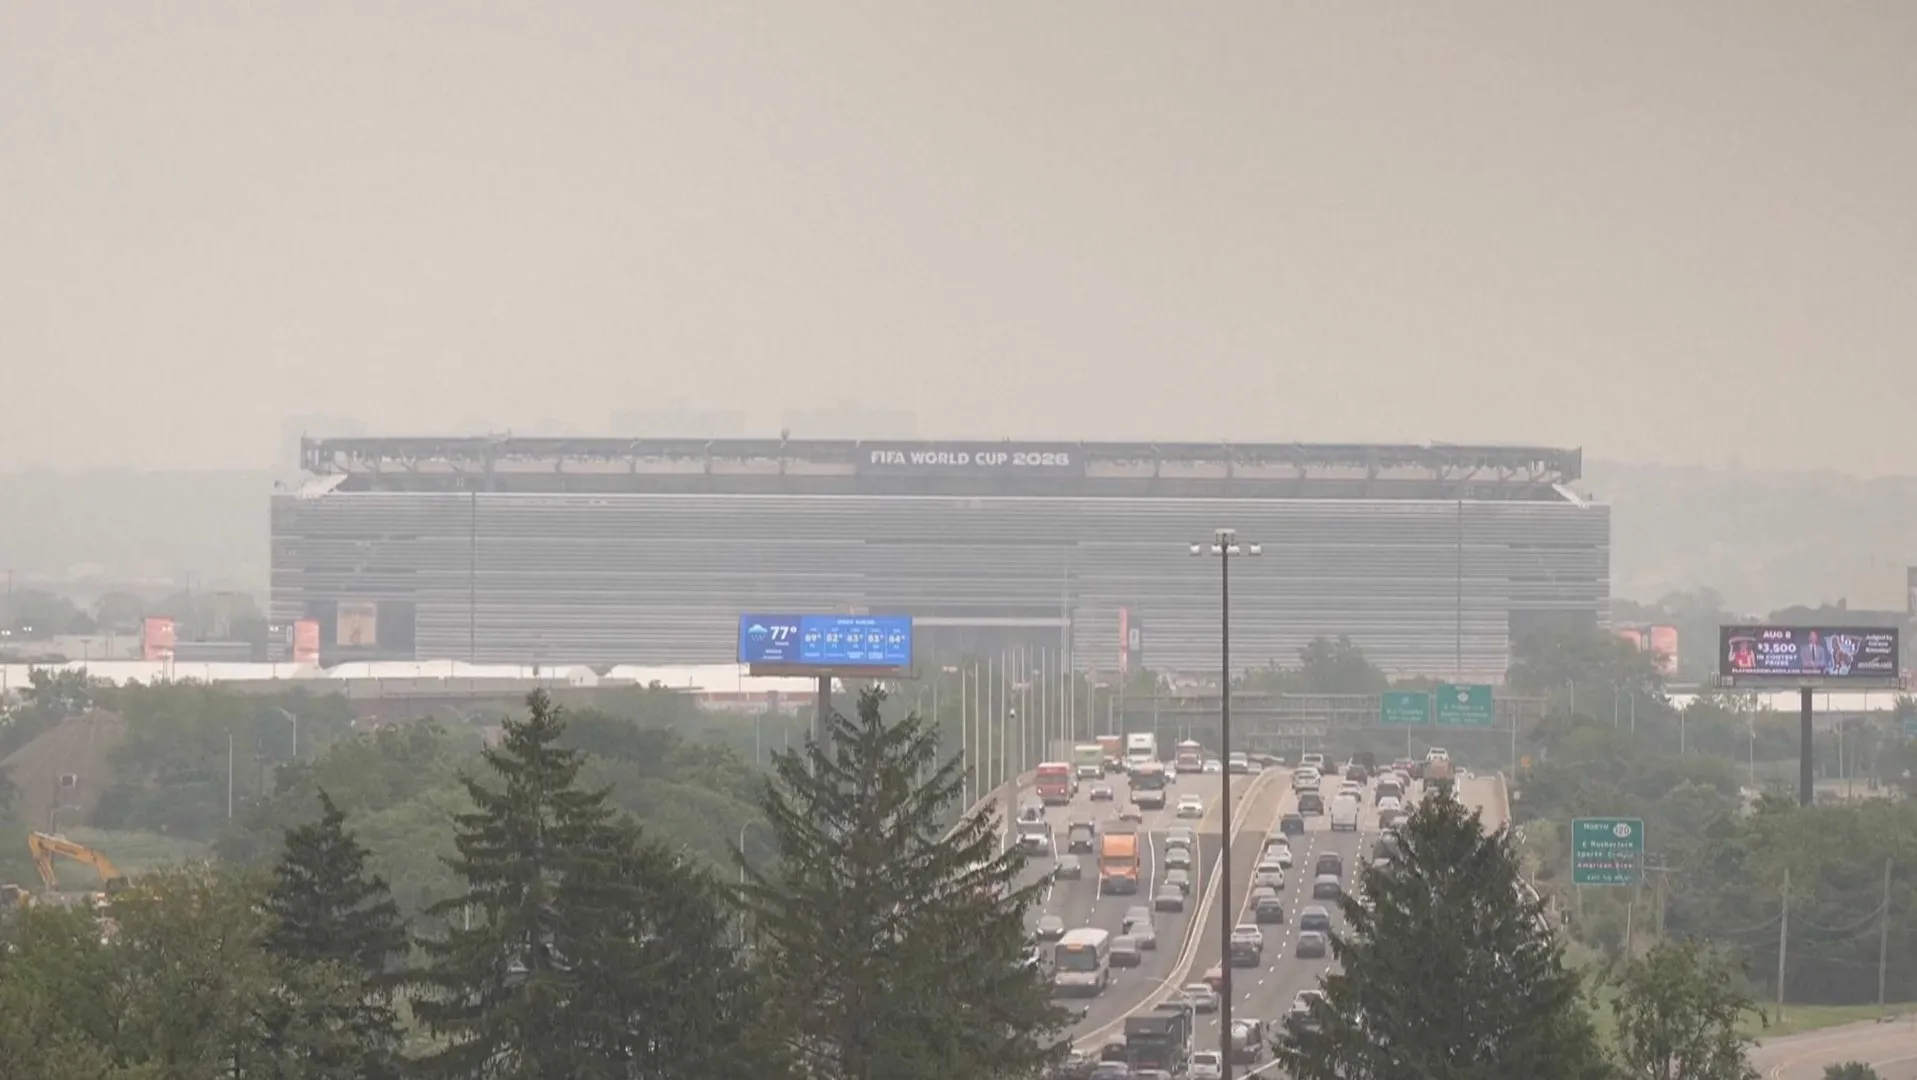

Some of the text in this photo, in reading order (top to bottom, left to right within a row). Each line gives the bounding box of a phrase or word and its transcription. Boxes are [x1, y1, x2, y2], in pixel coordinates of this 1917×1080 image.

[870, 451, 1070, 466] FIFA WORLD CUP 2026
[1763, 630, 1783, 639] AUG
